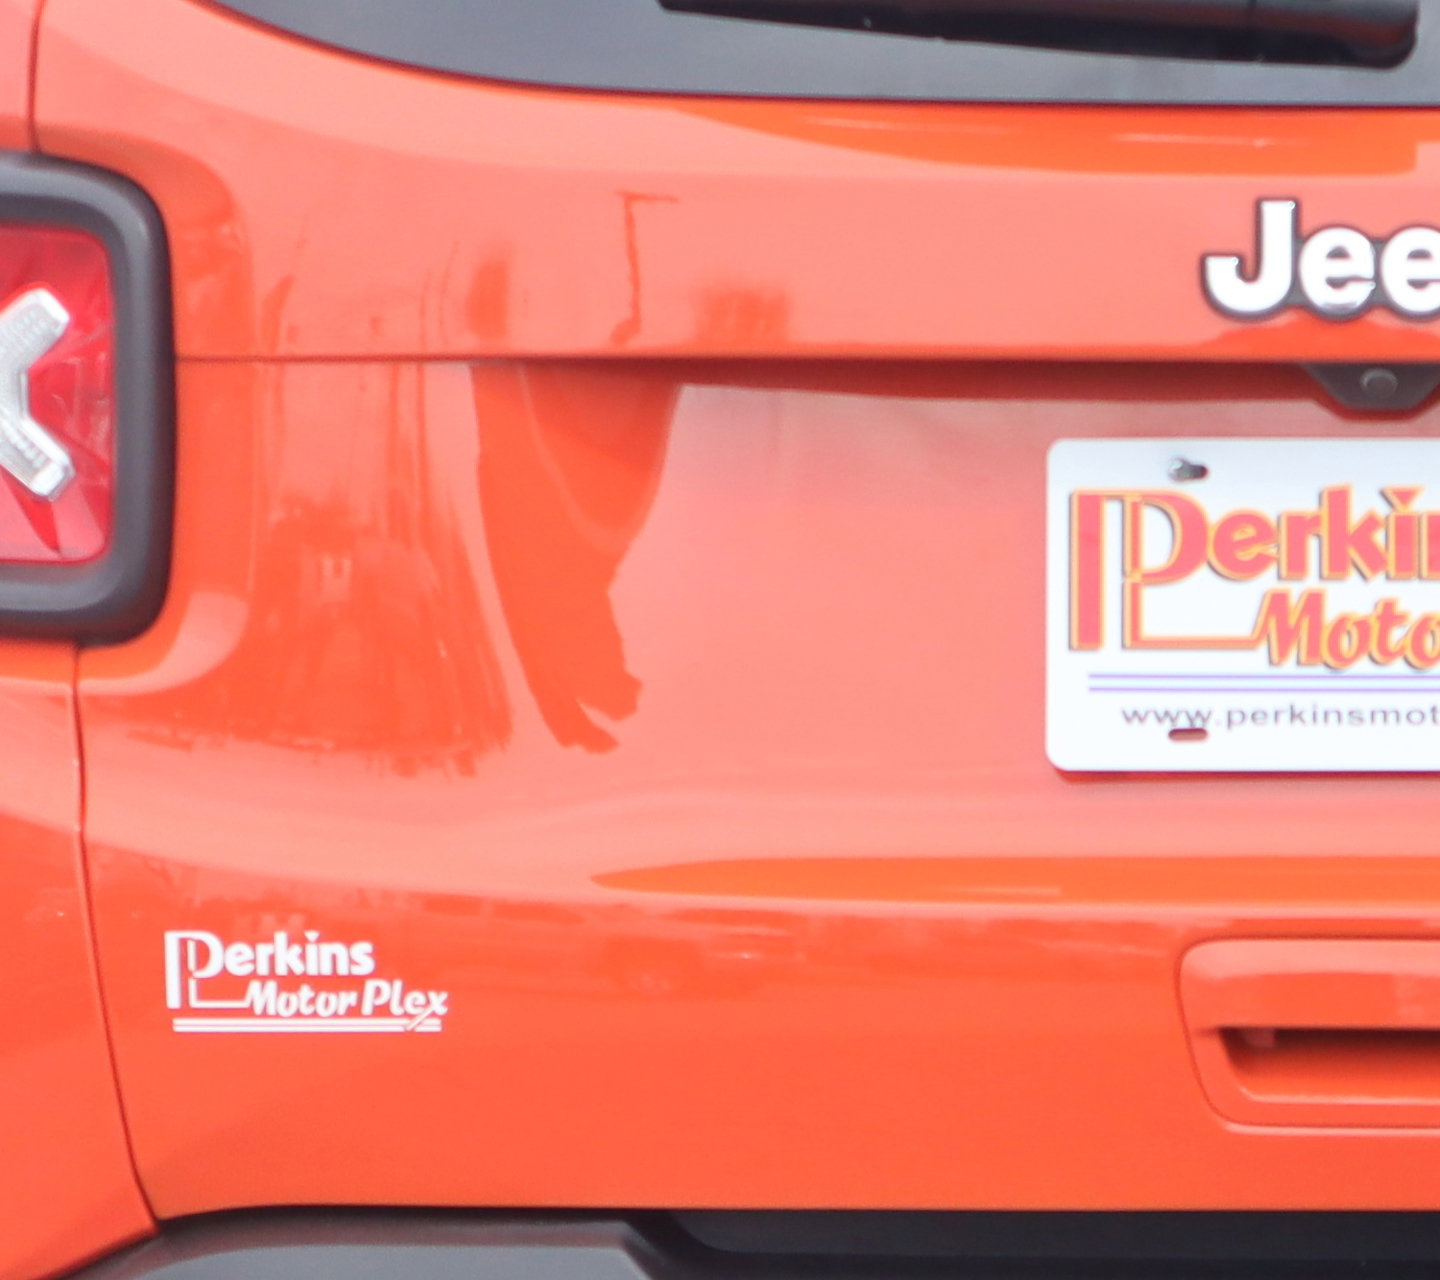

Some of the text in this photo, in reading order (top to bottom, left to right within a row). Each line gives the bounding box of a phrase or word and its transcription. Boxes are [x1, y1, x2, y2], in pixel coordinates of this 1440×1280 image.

[164, 931, 375, 1009] Perkins
[246, 979, 449, 1030] Motor Plex
